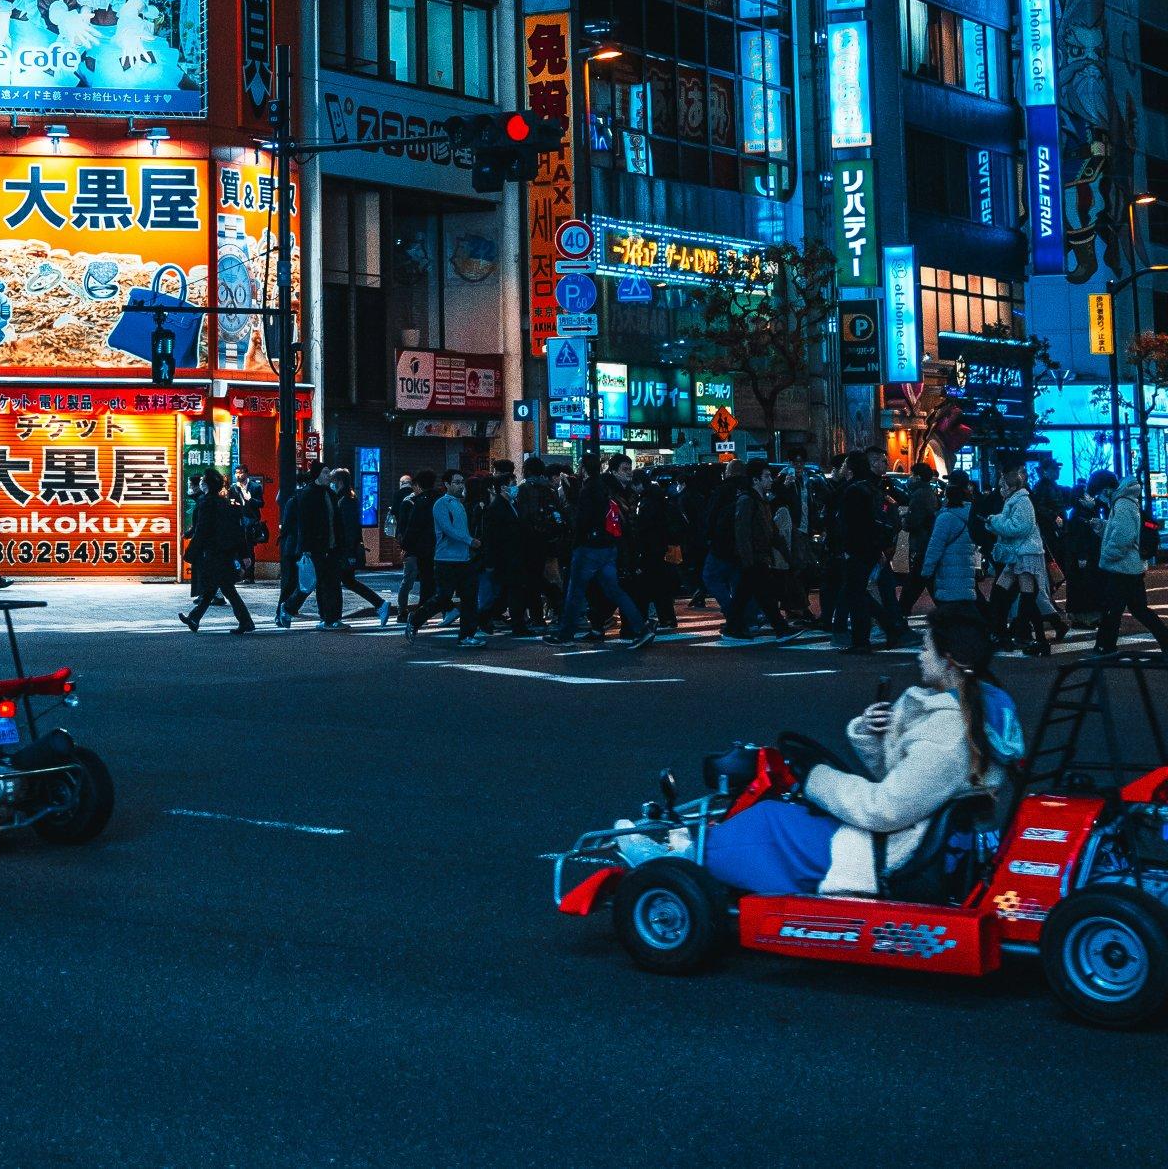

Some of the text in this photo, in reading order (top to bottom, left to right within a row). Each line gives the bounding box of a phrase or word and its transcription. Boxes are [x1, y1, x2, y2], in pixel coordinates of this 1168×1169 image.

[19, 45, 79, 70] cafe
[1033, 56, 1044, 93] cafe
[2, 164, 200, 231] 大黒屋
[1038, 146, 1054, 228] GALLERIA
[842, 169, 866, 278] リバティー
[563, 232, 587, 249] 40
[564, 285, 581, 309] P
[134, 392, 203, 412] 無料査定
[630, 380, 689, 408] リバティー
